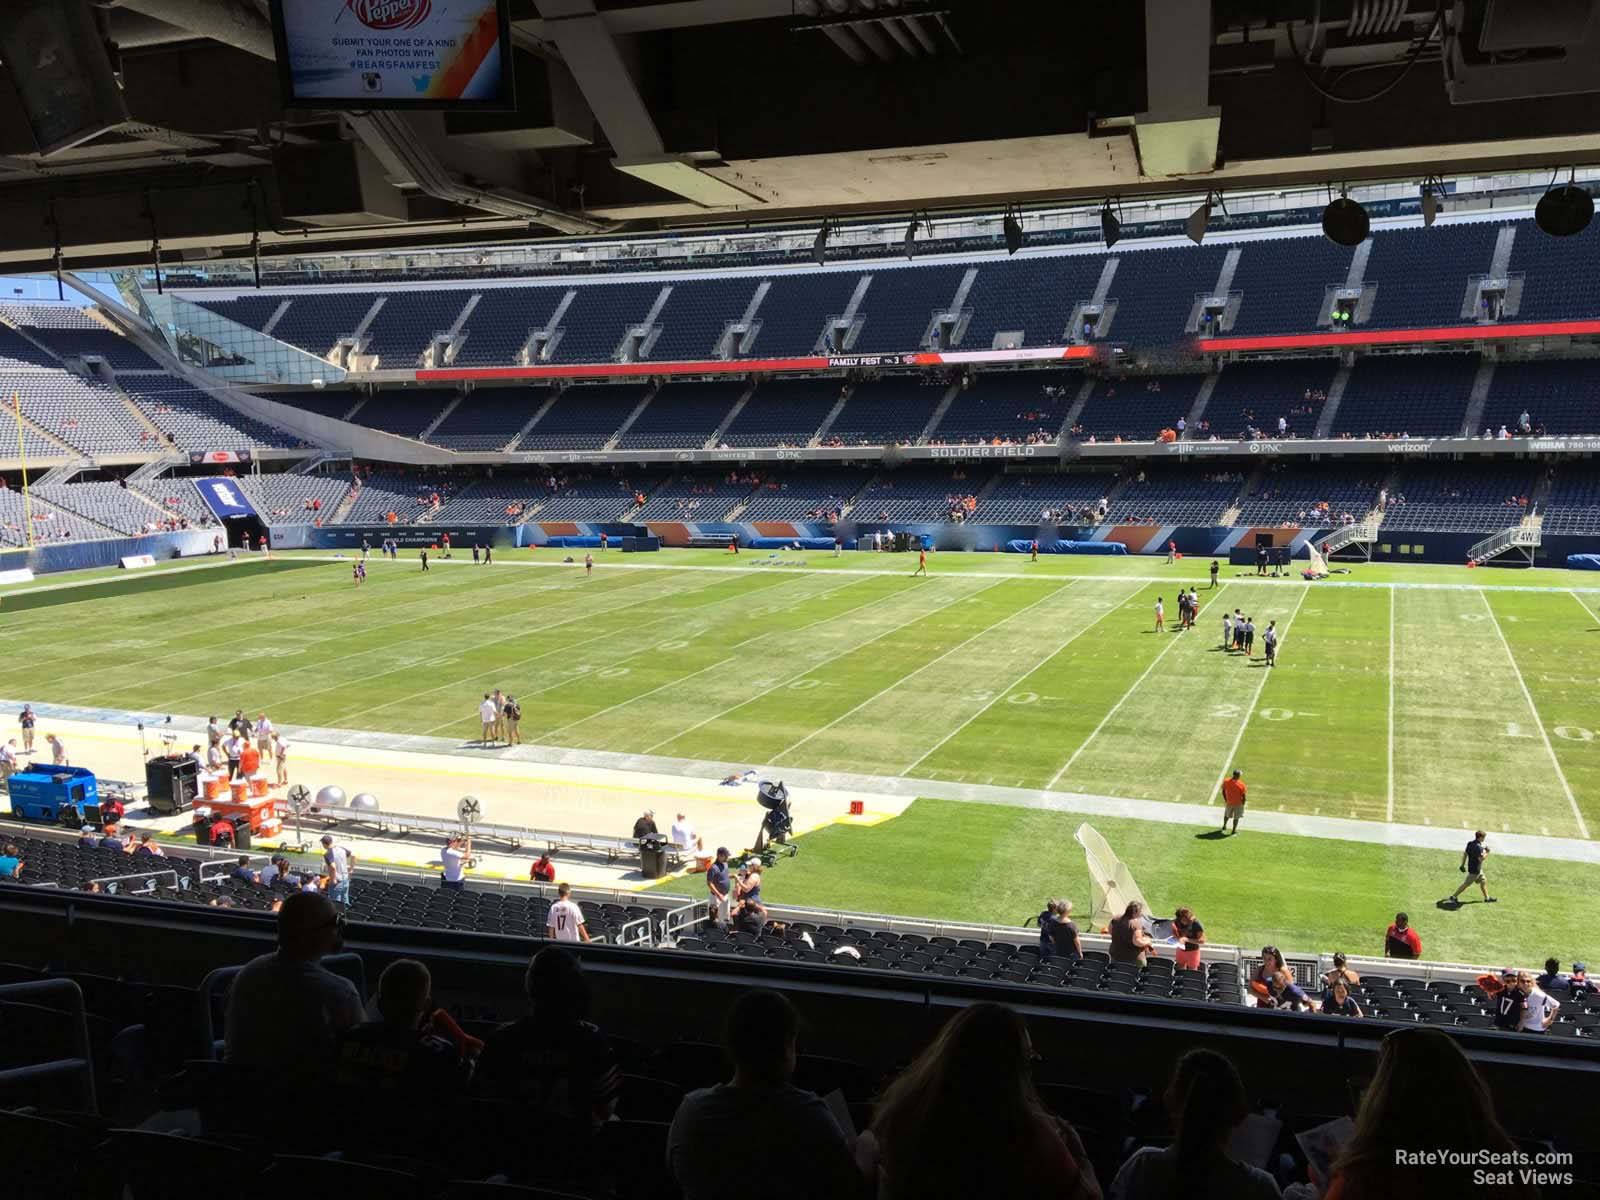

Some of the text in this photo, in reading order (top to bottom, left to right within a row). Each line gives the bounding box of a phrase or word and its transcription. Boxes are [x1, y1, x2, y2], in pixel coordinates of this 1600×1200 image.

[333, 38, 456, 47] SUBMIT YOUR ONE OF A KIND
[356, 49, 434, 57] FAN PHOTOS WITH
[829, 357, 859, 366] FAMILY
[860, 357, 881, 365] FEST
[931, 447, 1035, 457] SOLDIER FIELD
[1261, 443, 1282, 453] PNC
[557, 914, 567, 930] 17
[1500, 996, 1514, 1015] 17
